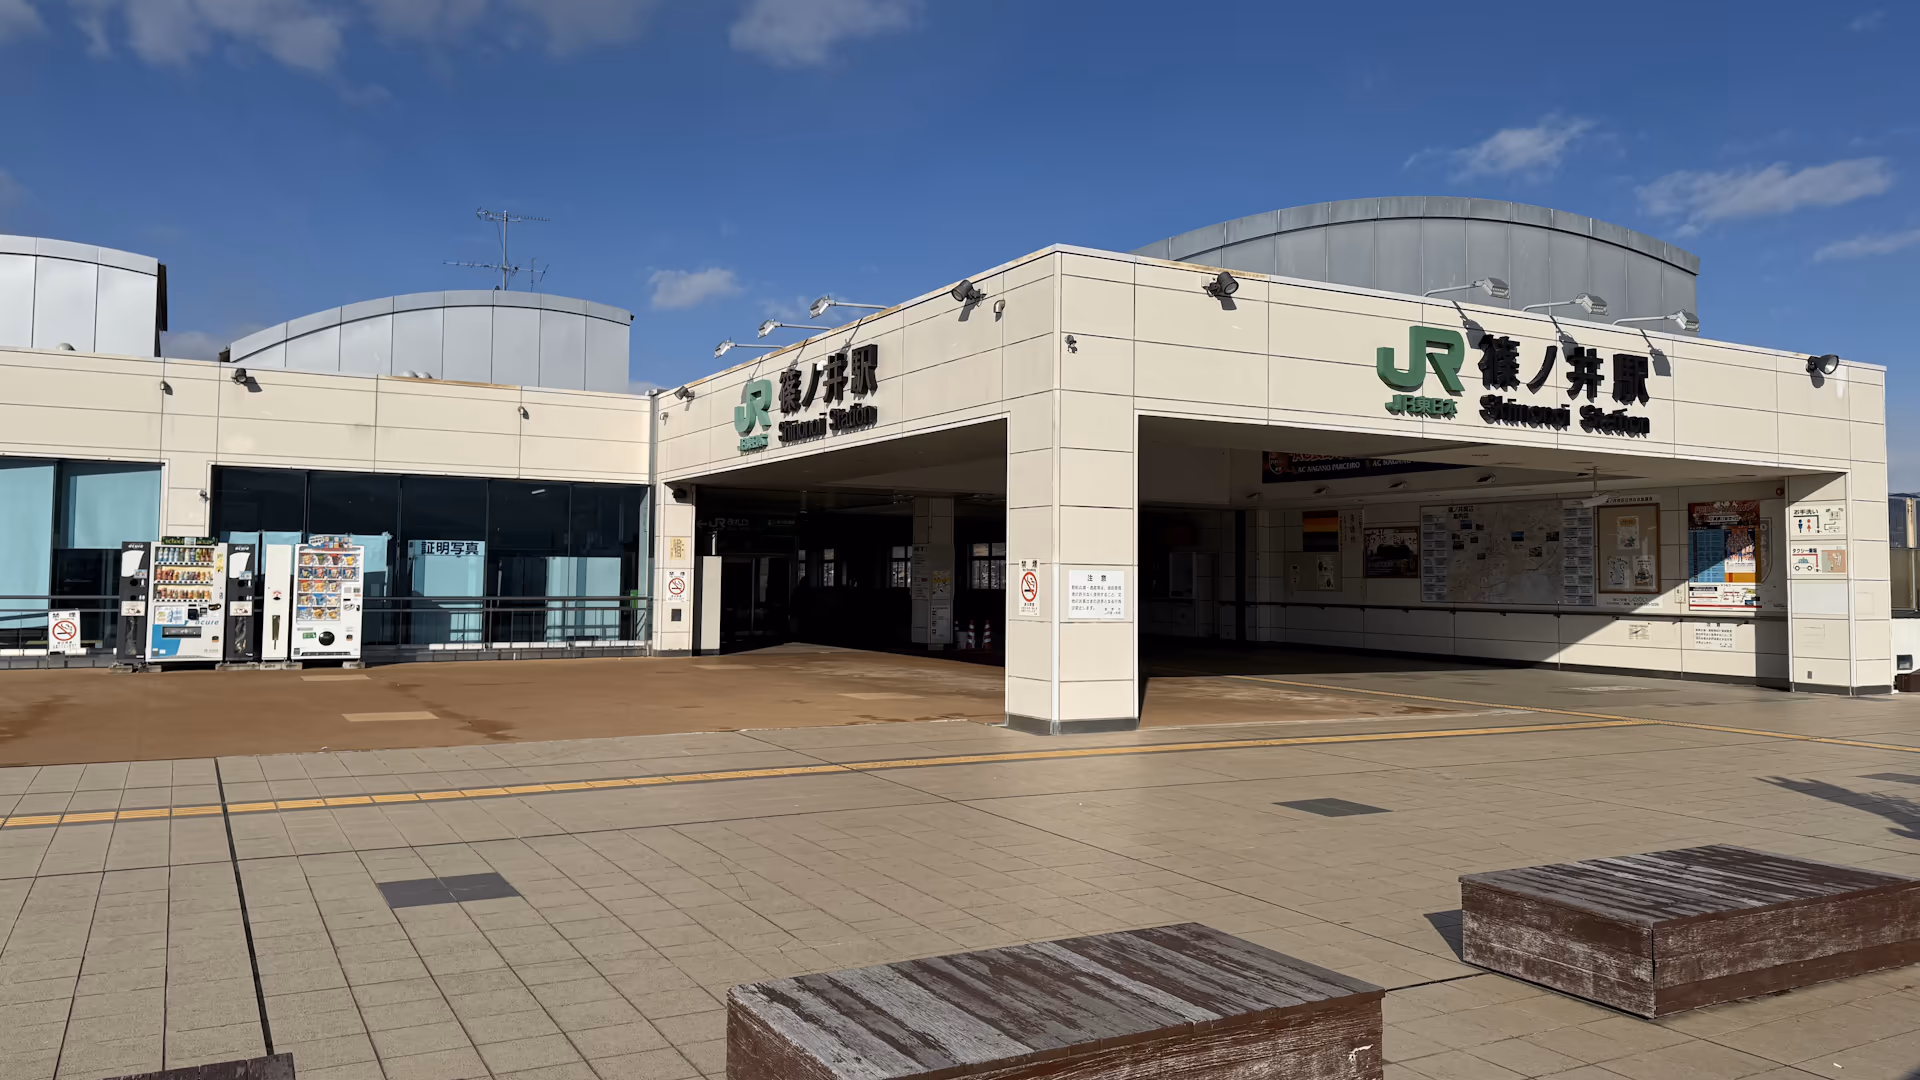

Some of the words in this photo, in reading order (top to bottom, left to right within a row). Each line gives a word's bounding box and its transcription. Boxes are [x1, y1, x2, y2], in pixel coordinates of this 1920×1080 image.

[778, 344, 878, 414] 篠ノ井駅
[1376, 325, 1464, 392] JR
[1478, 334, 1650, 404] 篠ノ井駅
[734, 379, 772, 434] JR
[778, 412, 827, 442] Shinonoi
[829, 402, 878, 431] Station
[1385, 394, 1457, 419] JR東日本
[1479, 394, 1570, 430] Shinonoi
[1579, 404, 1650, 436] Station
[421, 541, 479, 555] 証明写真
